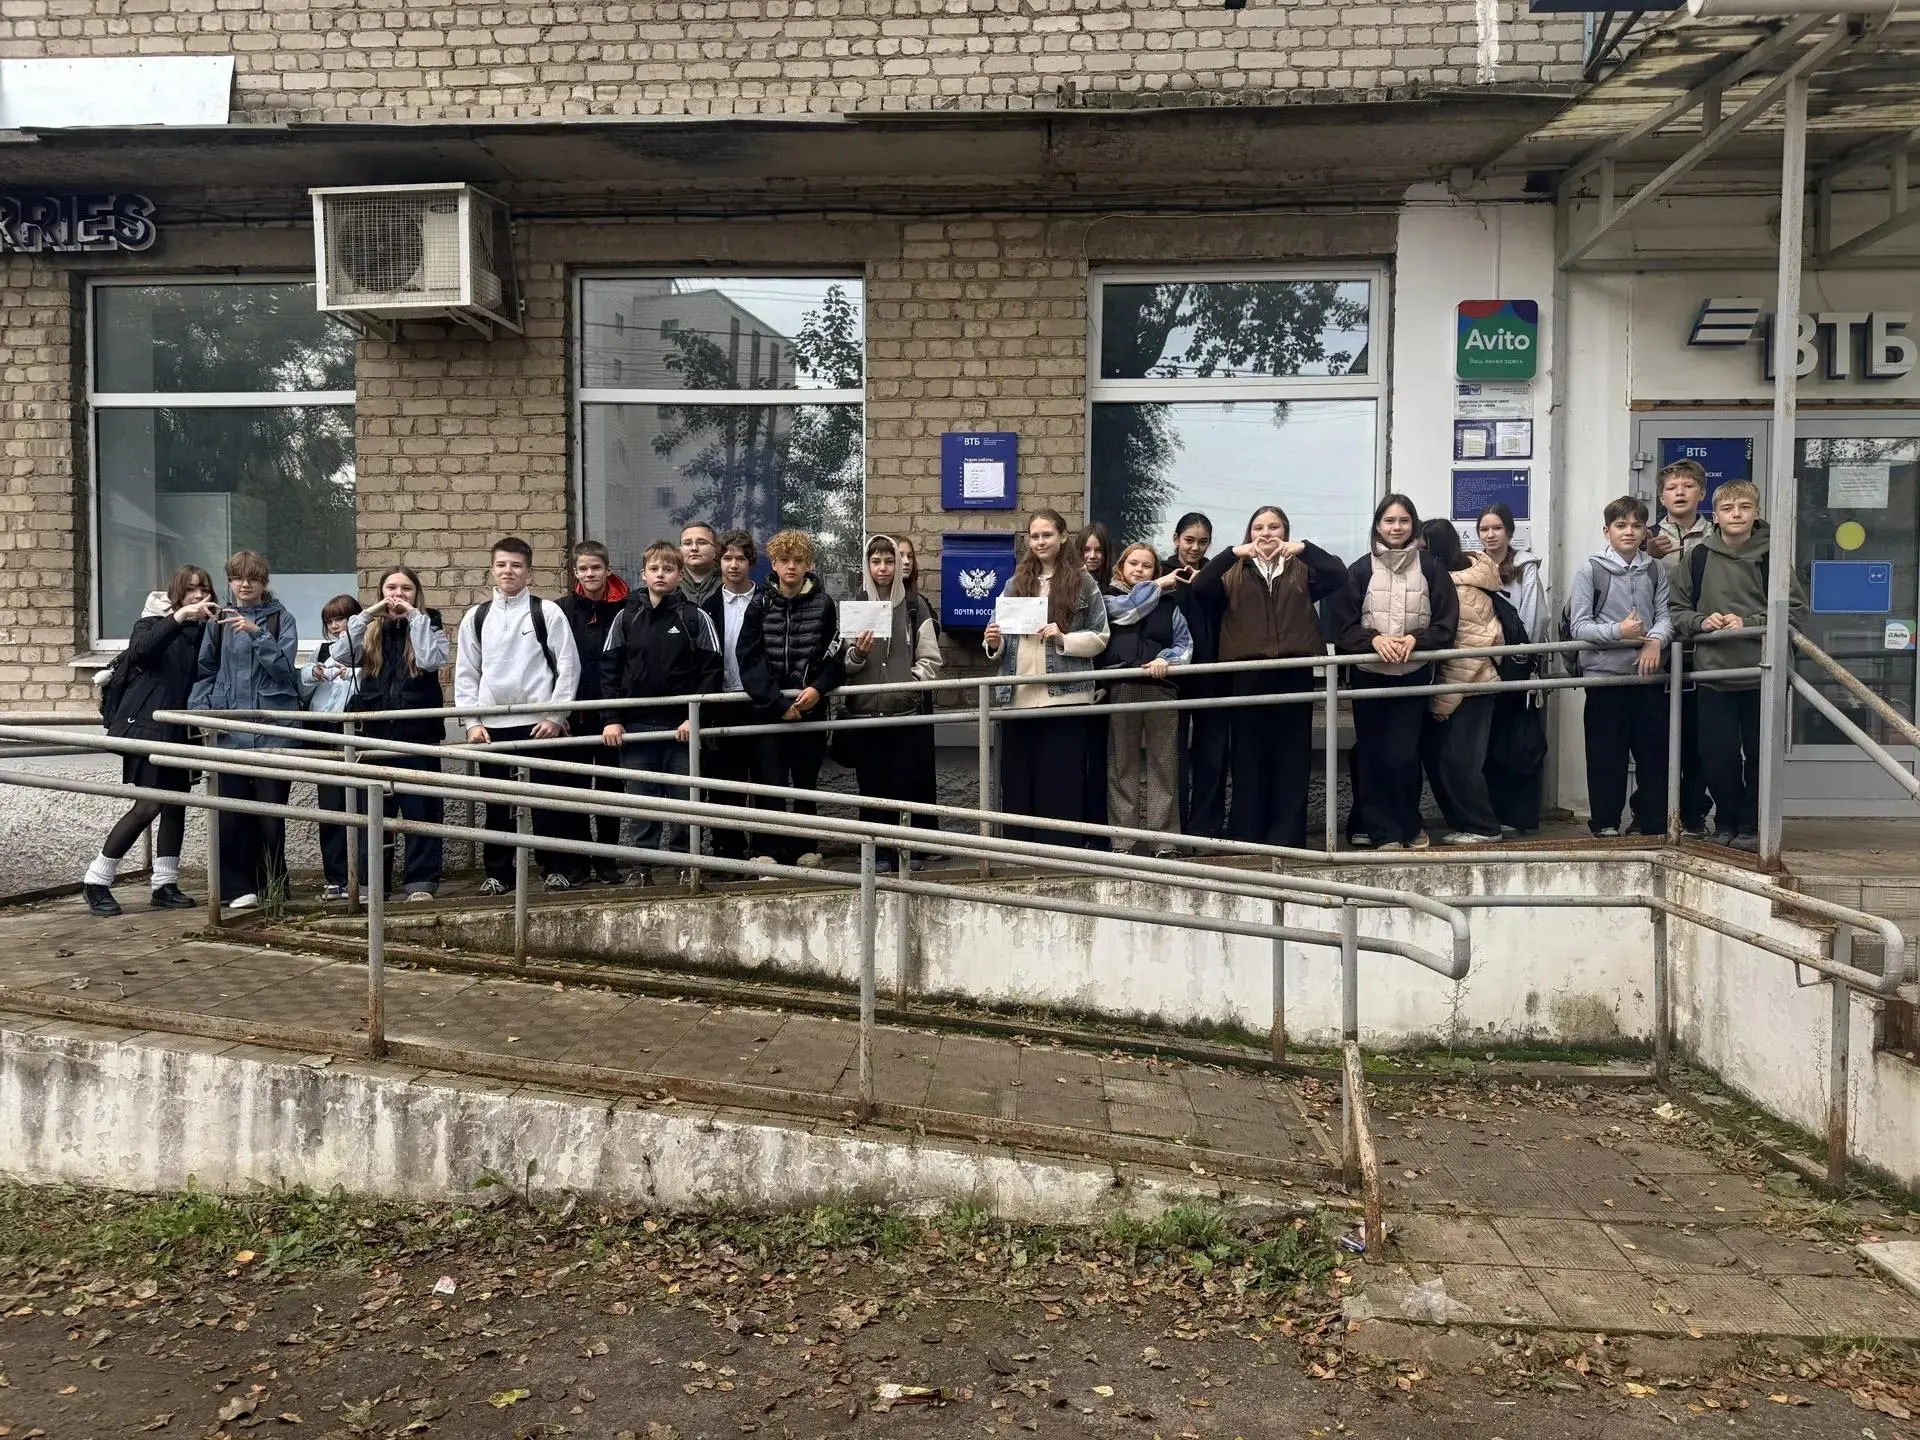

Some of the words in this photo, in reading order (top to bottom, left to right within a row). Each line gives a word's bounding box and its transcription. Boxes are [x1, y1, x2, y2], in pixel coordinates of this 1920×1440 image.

[1464, 327, 1531, 351] Avito
[964, 437, 981, 446] ВТБ
[1686, 447, 1708, 457] ВТБ
[954, 608, 974, 616] ПОЧТА
